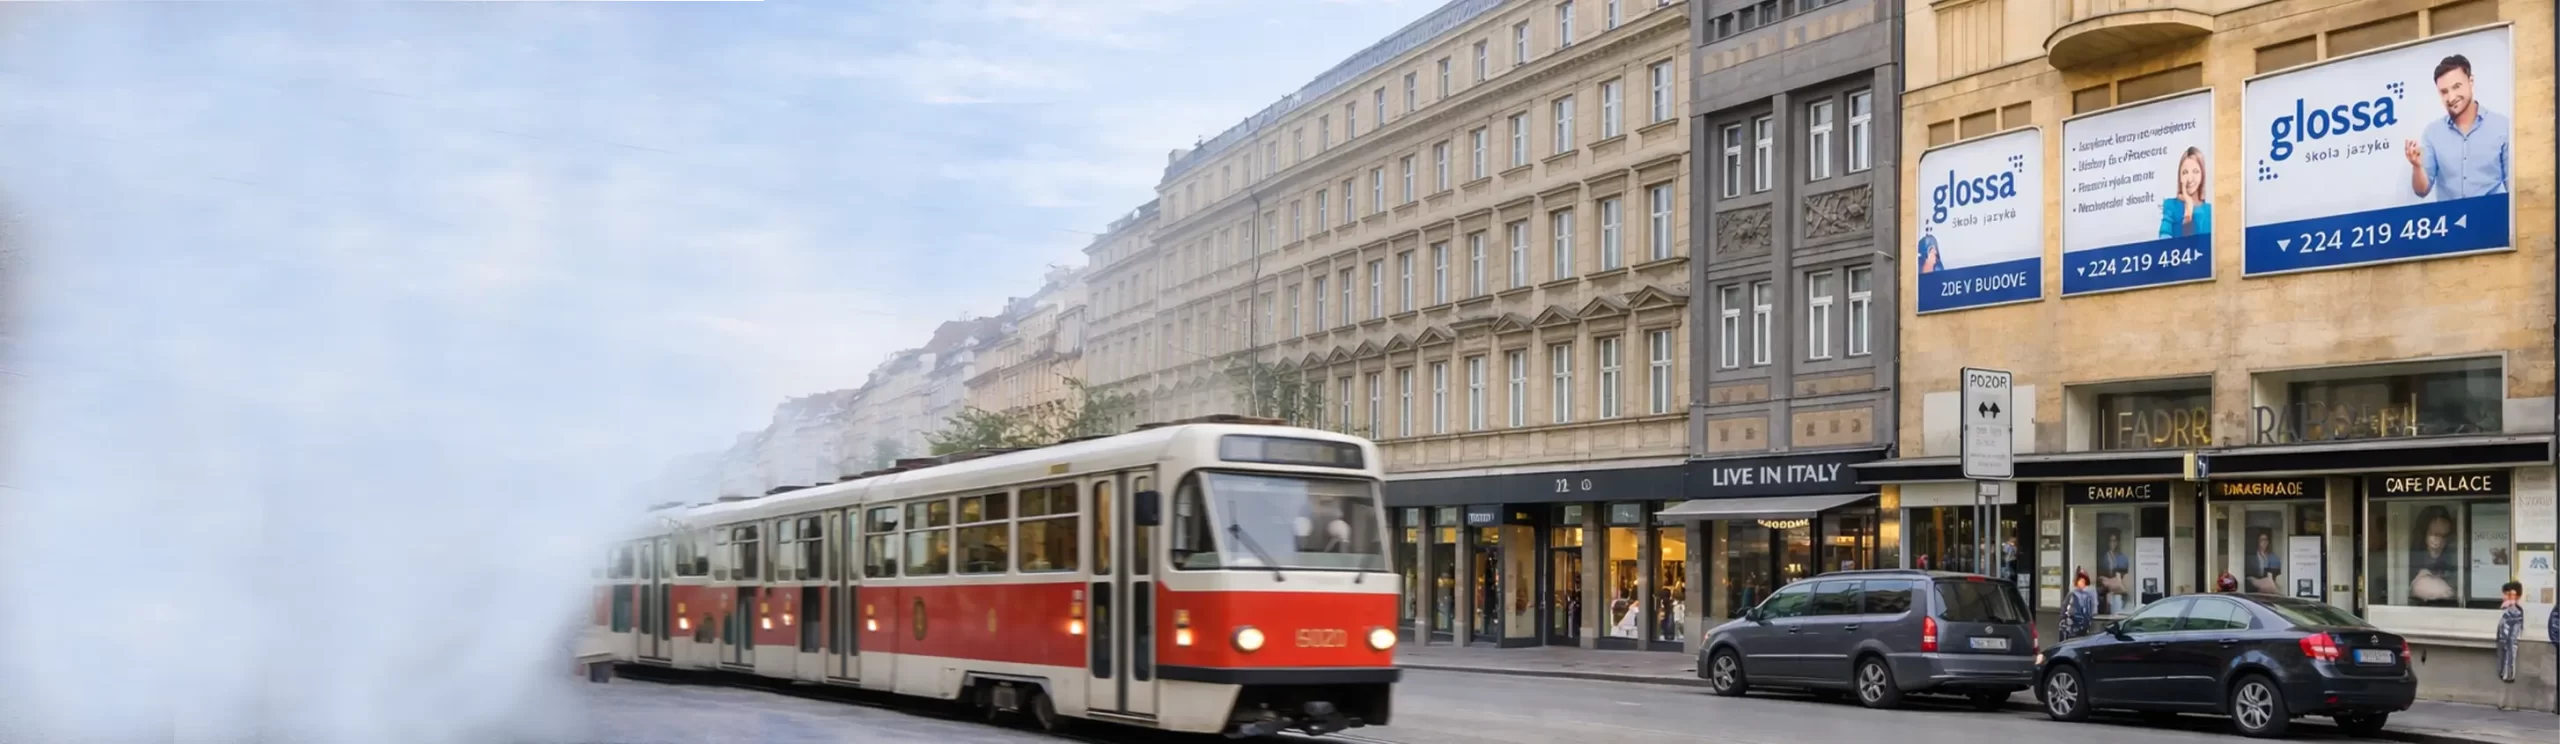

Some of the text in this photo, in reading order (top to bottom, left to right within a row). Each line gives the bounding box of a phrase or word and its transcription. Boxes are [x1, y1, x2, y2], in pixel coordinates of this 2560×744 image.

[2270, 96, 2398, 161] glossa
[1933, 170, 2017, 224] glossa
[2299, 215, 2448, 254] 224 219 484
[2088, 247, 2191, 278] 224 219 484
[1963, 279, 1972, 294] V
[1713, 462, 1841, 486] LIVE IN ITALY
[2386, 475, 2492, 493] CAFE PALACE
